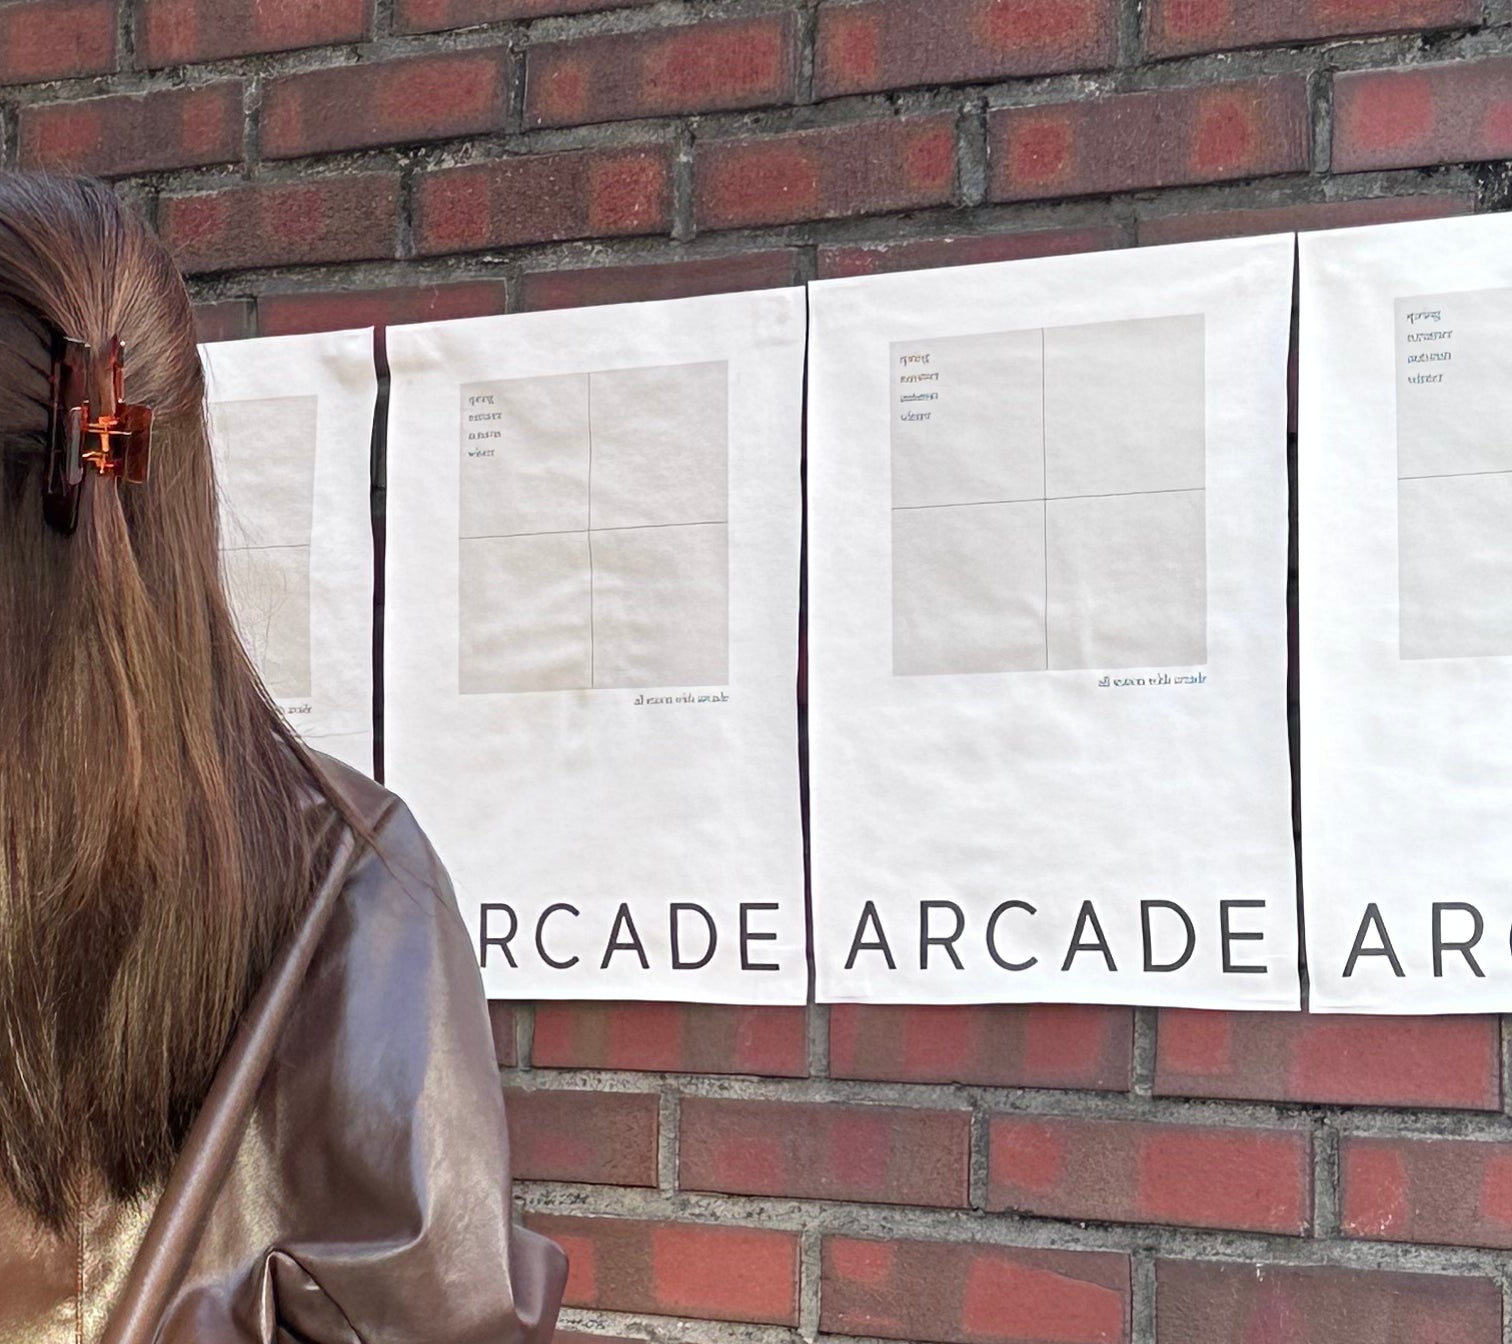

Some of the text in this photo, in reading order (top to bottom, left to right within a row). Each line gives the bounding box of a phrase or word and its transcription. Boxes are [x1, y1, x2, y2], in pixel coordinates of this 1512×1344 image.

[479, 902, 781, 971] RCADE
[844, 899, 1268, 974] ARCADE
[1342, 901, 1512, 978] AR
